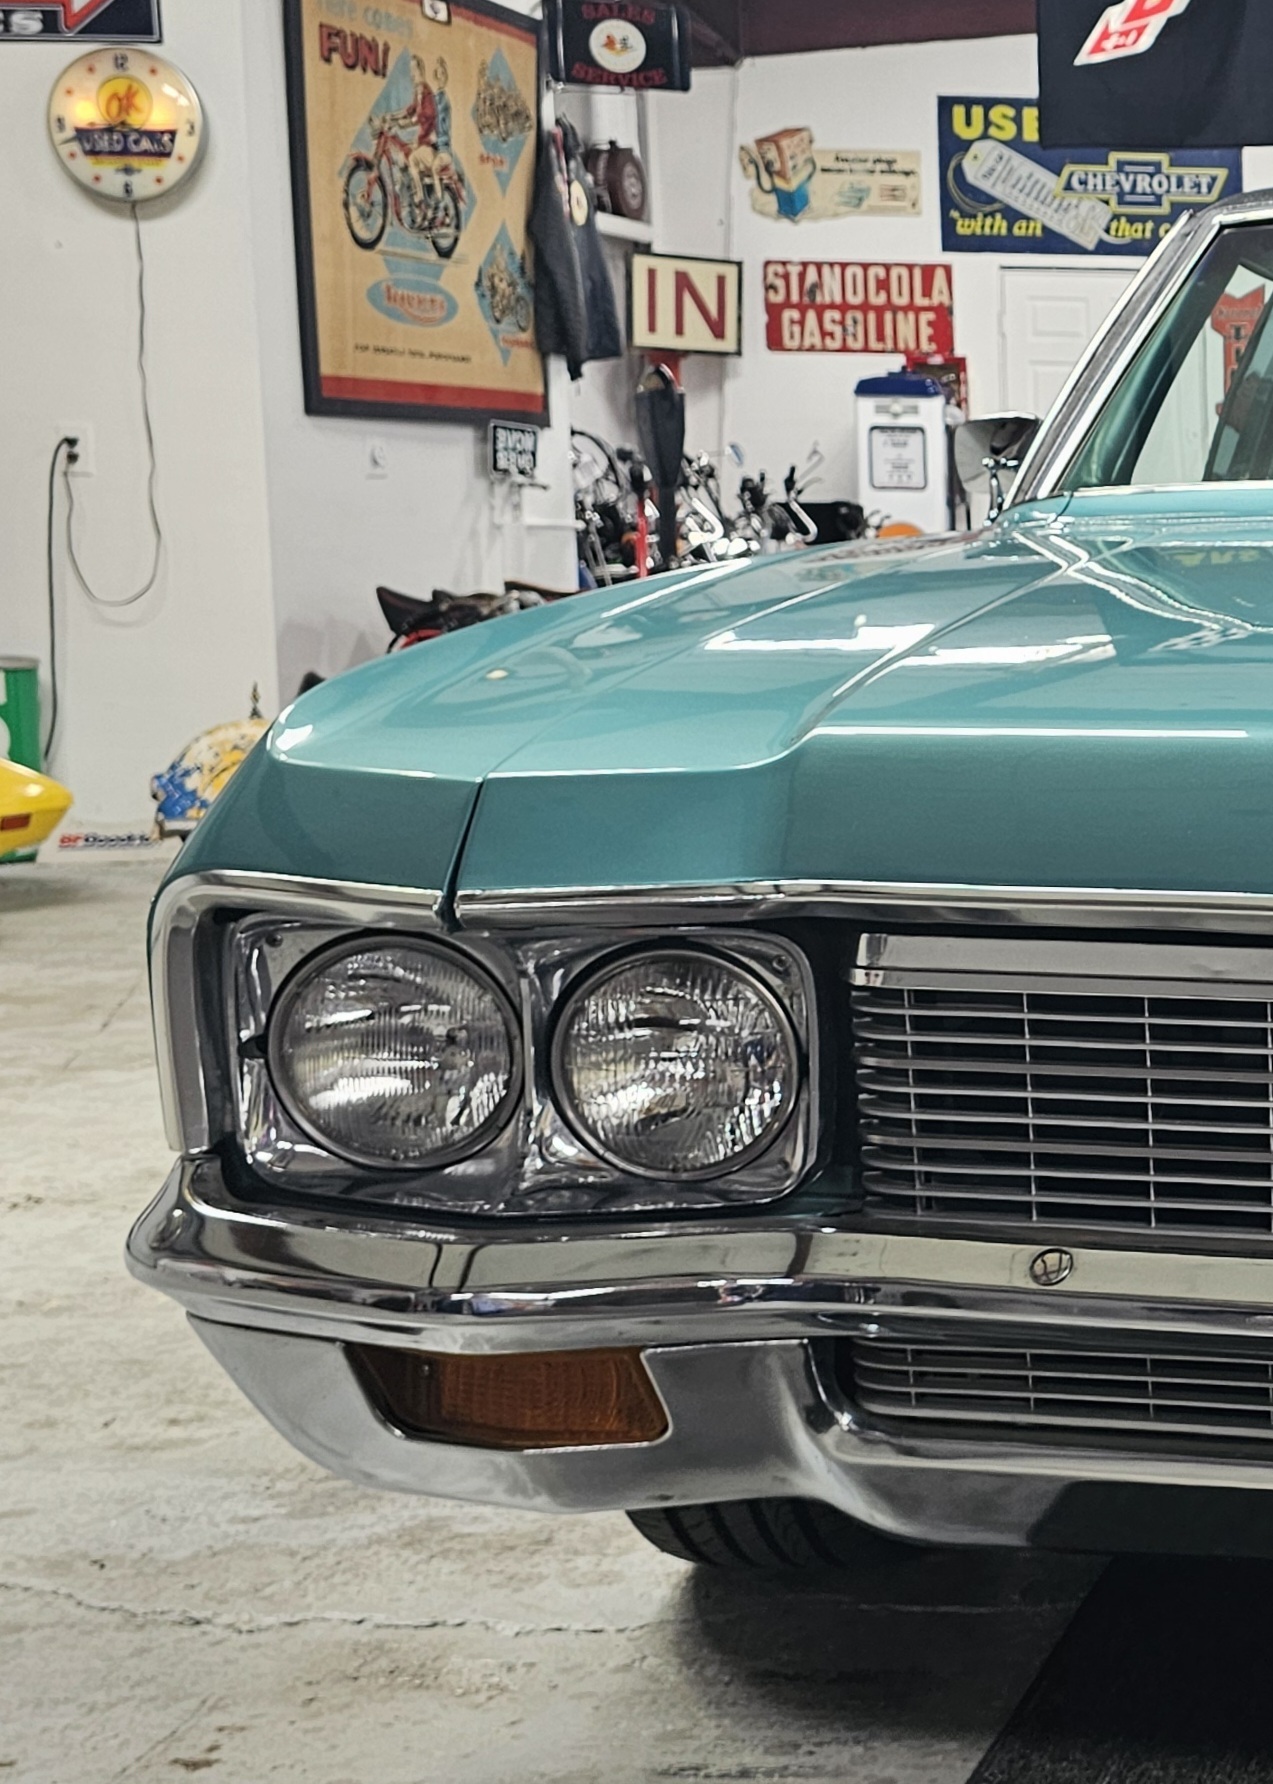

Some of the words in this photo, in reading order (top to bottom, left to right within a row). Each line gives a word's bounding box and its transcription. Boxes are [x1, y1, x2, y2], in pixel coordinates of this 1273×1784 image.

[582, 3, 655, 24] SALES
[319, 22, 390, 78] FUN!
[572, 62, 668, 86] SERVICE
[105, 84, 142, 119] OK
[82, 133, 123, 152] USED
[127, 133, 173, 153] CARS
[1070, 170, 1213, 195] CHEVROLET
[1012, 218, 1043, 238] an
[1109, 216, 1154, 239] that
[765, 262, 951, 307] STANOCOLA
[647, 267, 727, 340] IN
[780, 308, 938, 352] GASOLINE
